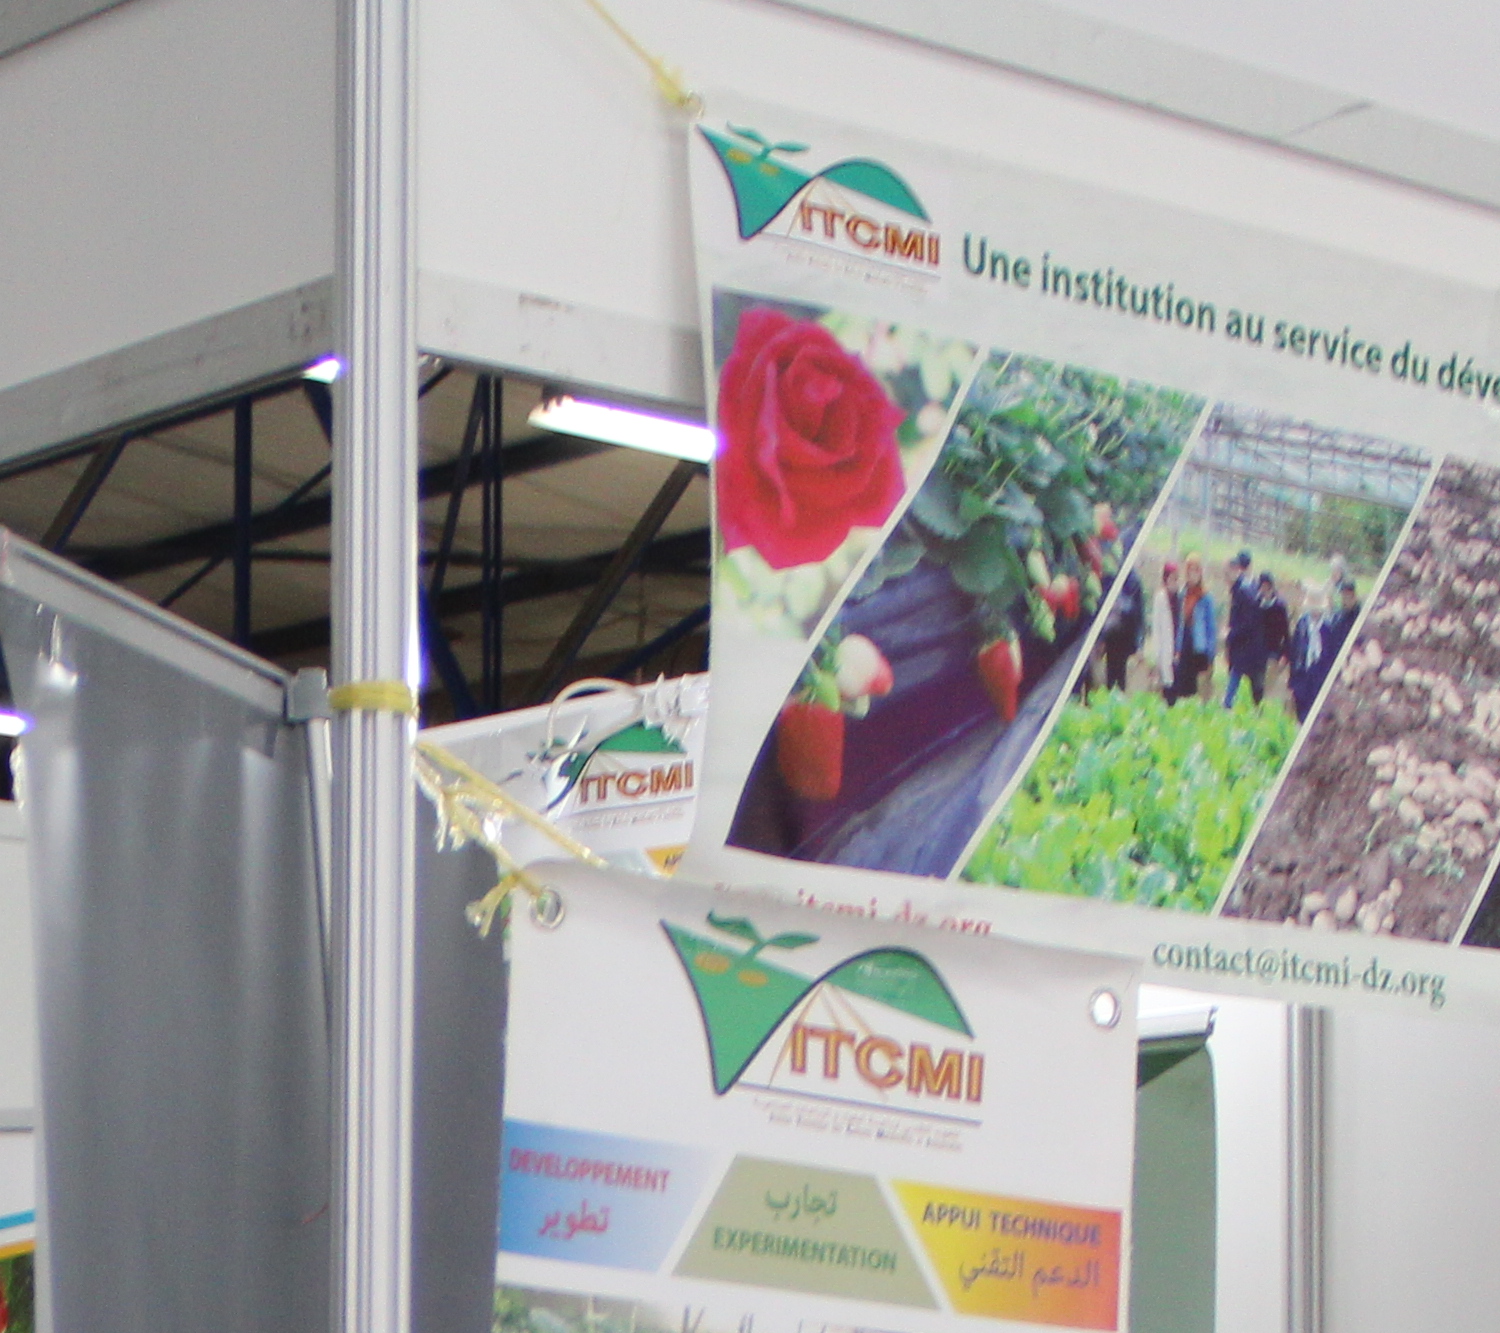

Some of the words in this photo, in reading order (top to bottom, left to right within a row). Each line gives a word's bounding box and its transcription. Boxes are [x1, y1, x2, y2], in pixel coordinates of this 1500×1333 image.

[800, 197, 941, 266] ITCMI
[961, 232, 1031, 288] Une
[1040, 255, 1218, 333] institution
[1225, 309, 1266, 345] au
[1274, 319, 1383, 375] service
[1390, 340, 1429, 385] du
[580, 760, 695, 804] ITCMI
[790, 1020, 985, 1105] ITCMI
[508, 1145, 671, 1194] DEVELOPPEMENT
[537, 1200, 611, 1240] تطوير
[764, 1183, 839, 1227] تجارب
[921, 1201, 981, 1232] APPUI
[988, 1210, 1104, 1246] TECHNIQUE
[712, 1230, 899, 1275] EXPERIMENTATION
[958, 1248, 1025, 1289] التقني
[1029, 1259, 1101, 1299] الدعم
